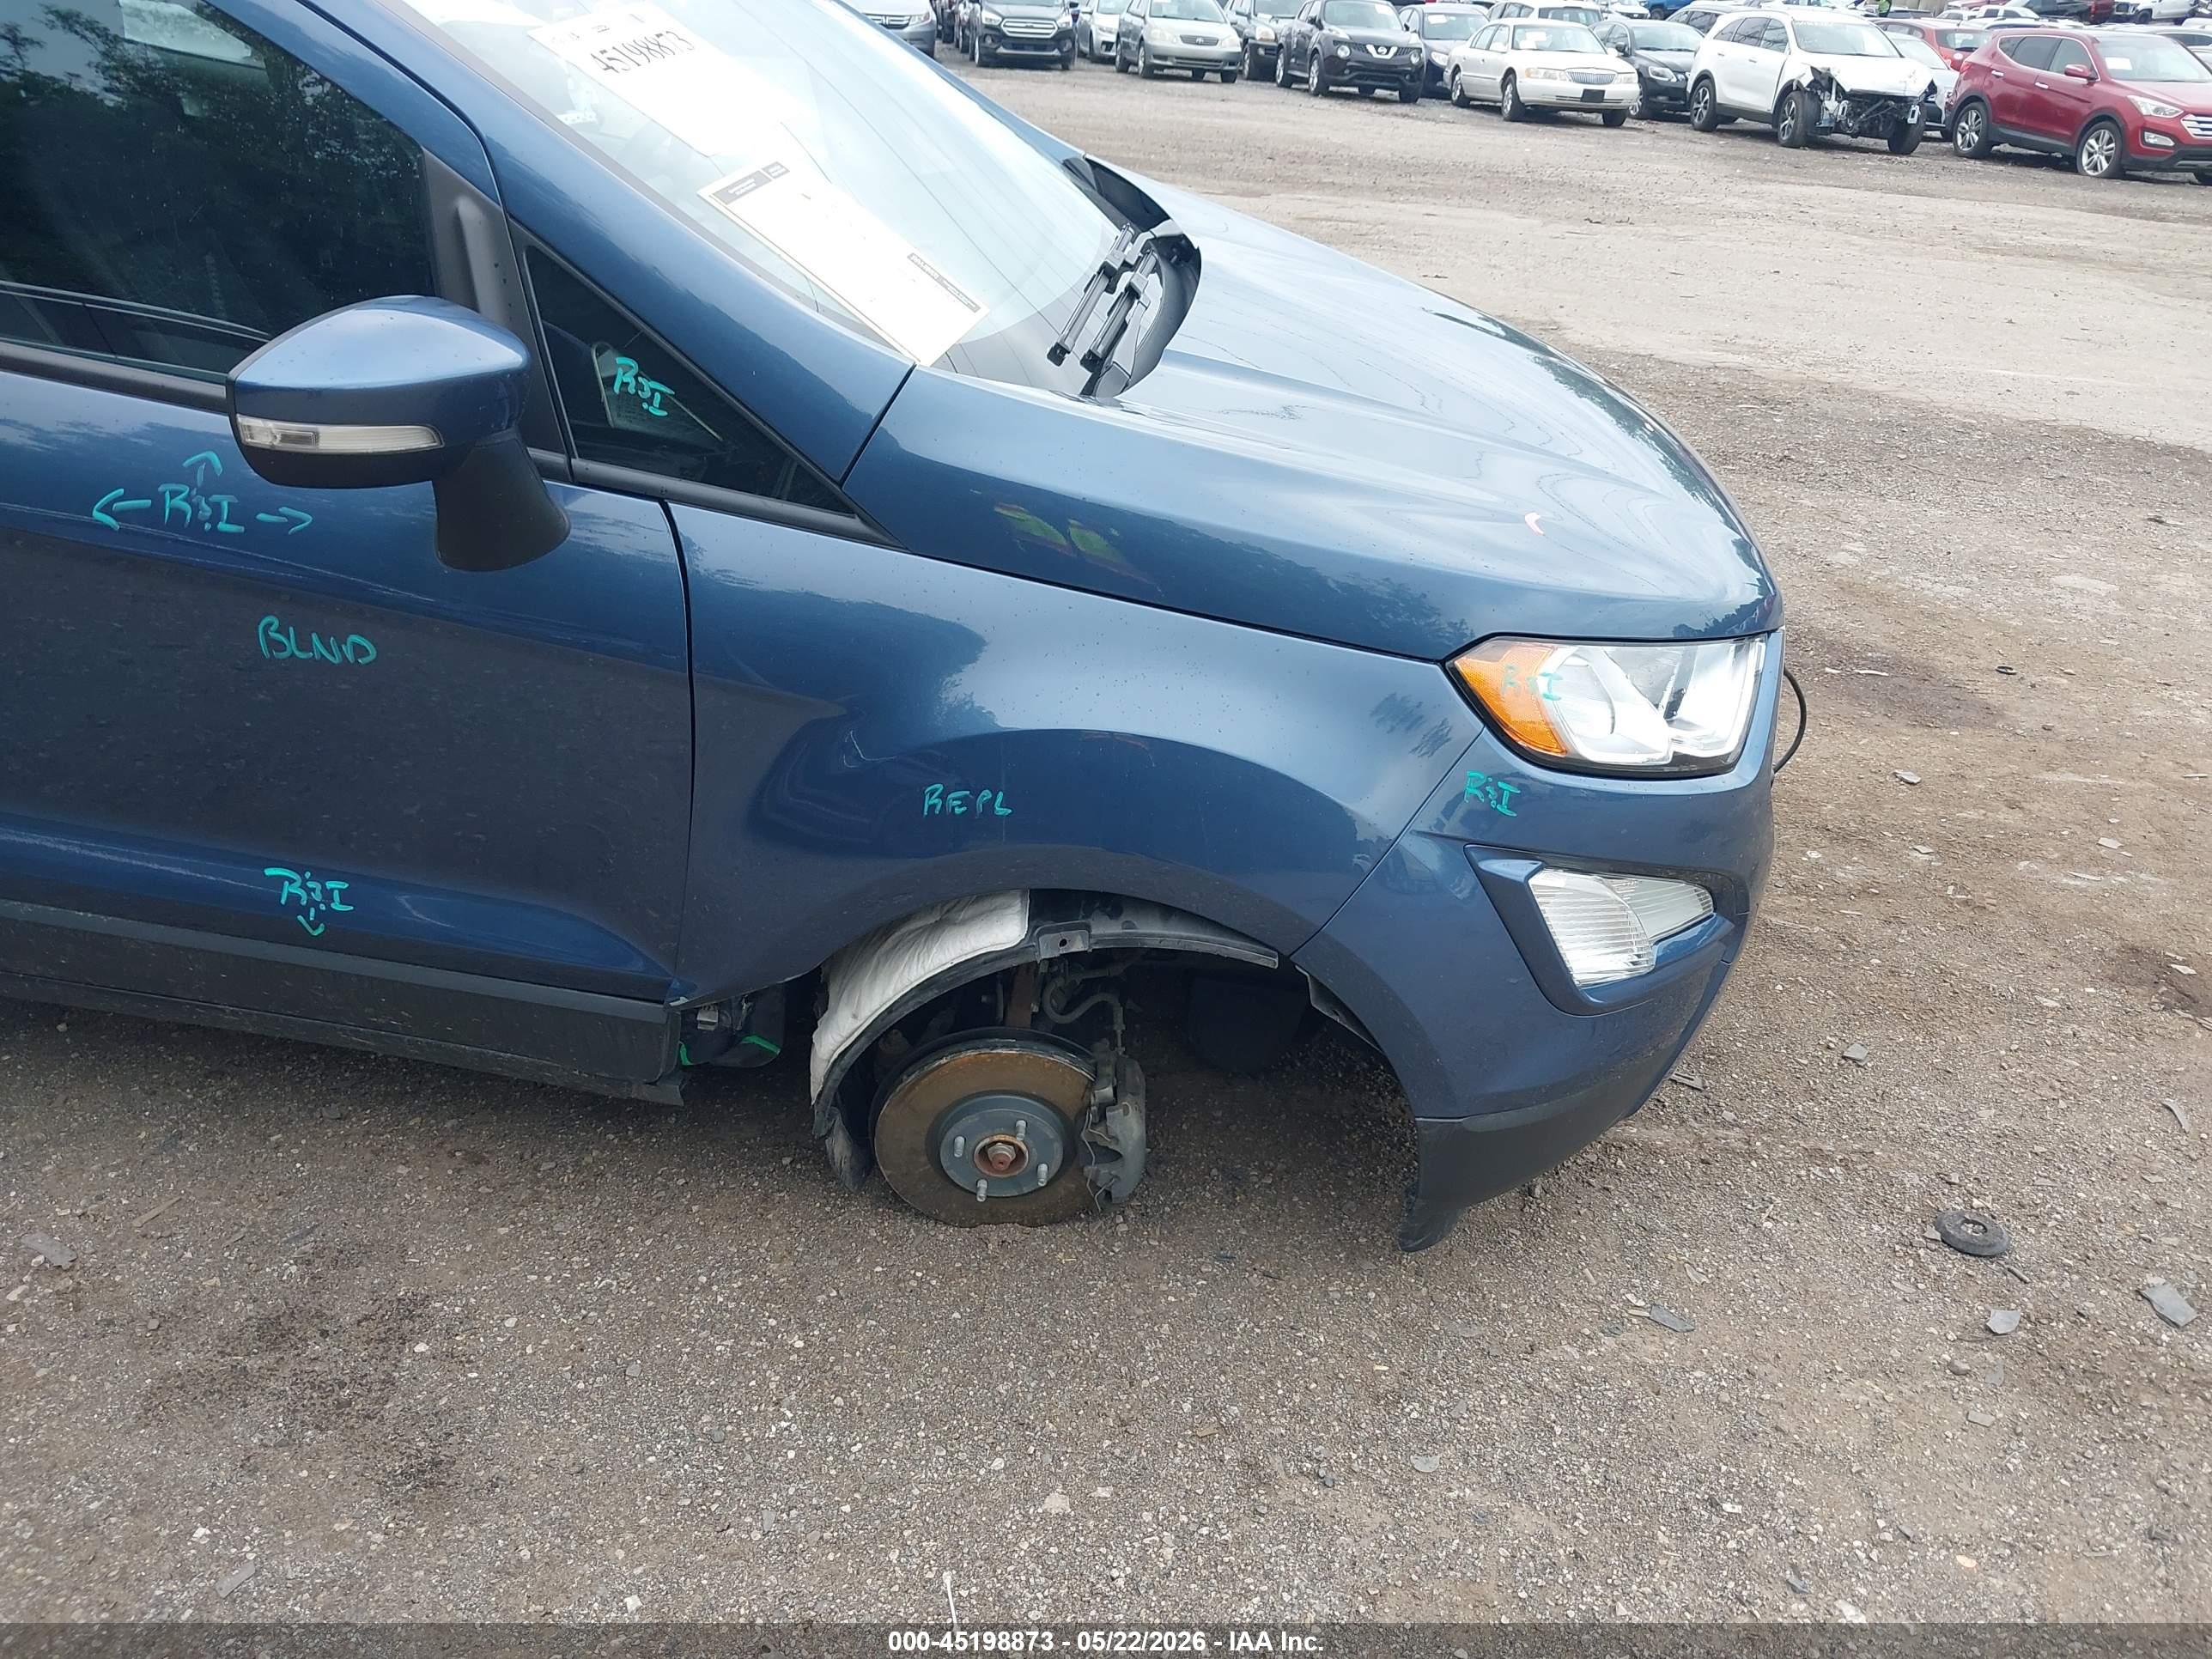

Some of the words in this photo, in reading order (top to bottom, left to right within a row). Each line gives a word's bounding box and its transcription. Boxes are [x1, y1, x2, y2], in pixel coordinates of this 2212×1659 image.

[589, 30, 696, 74] 45198873
[258, 614, 378, 666] BLND
[921, 782, 1015, 818] REPL
